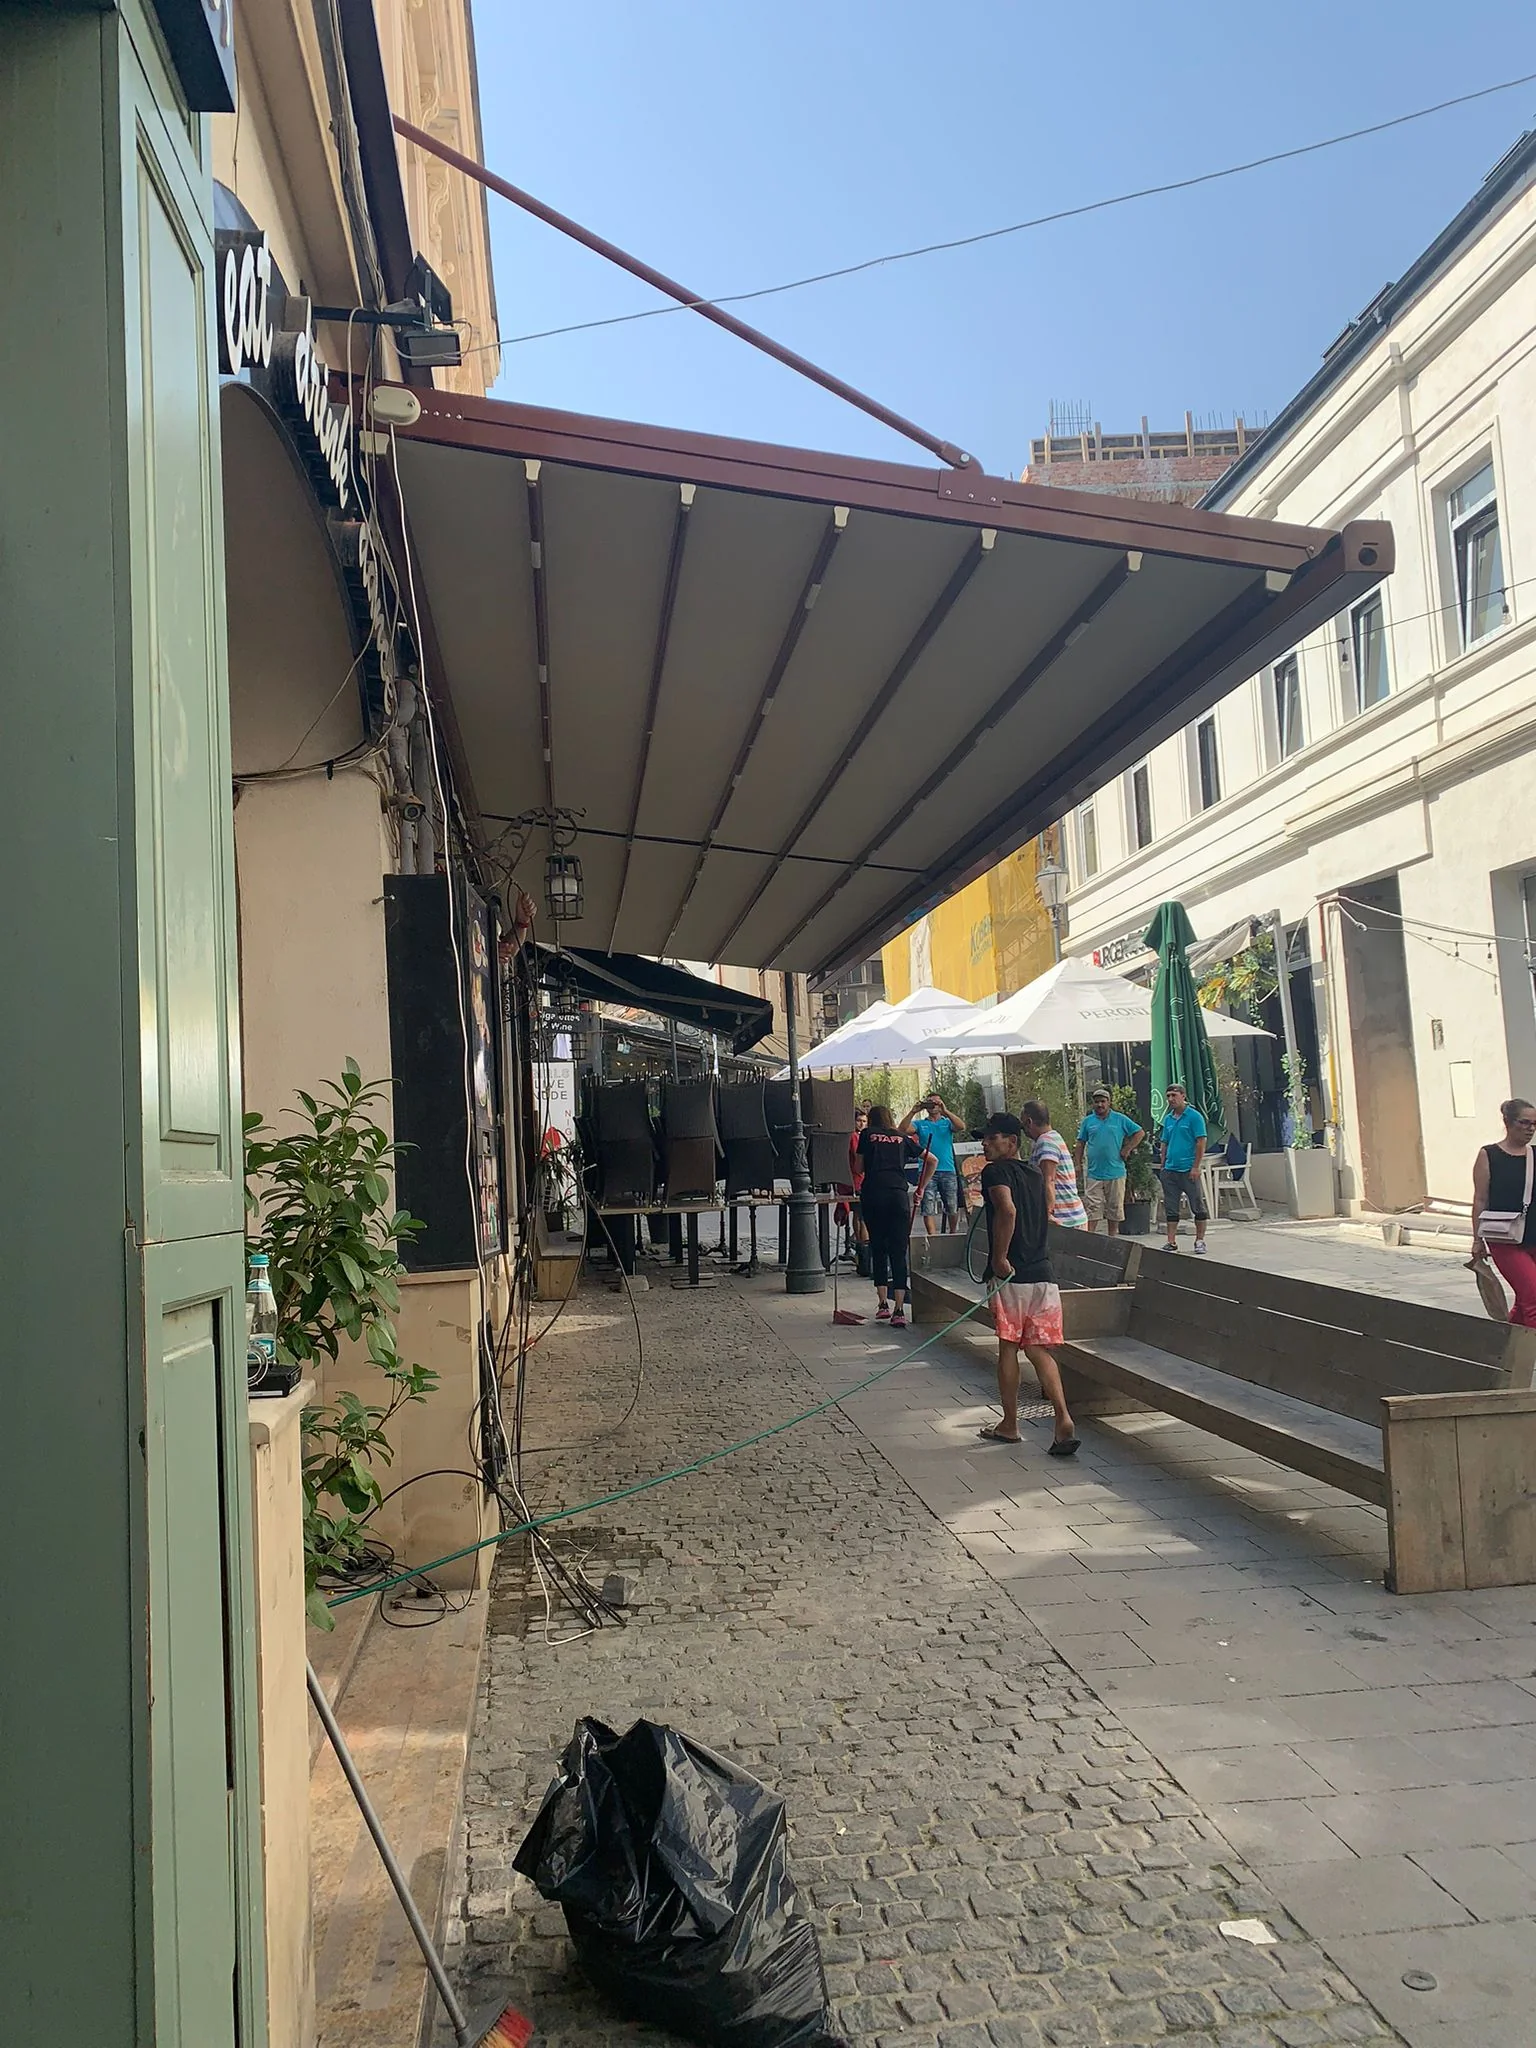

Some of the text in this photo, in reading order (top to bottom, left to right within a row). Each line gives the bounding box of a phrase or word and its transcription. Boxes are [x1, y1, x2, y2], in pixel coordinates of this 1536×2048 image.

[224, 230, 273, 376] eat
[295, 296, 350, 509] drink
[1079, 1007, 1150, 1020] PERONI
[869, 1133, 904, 1144] STAFF
